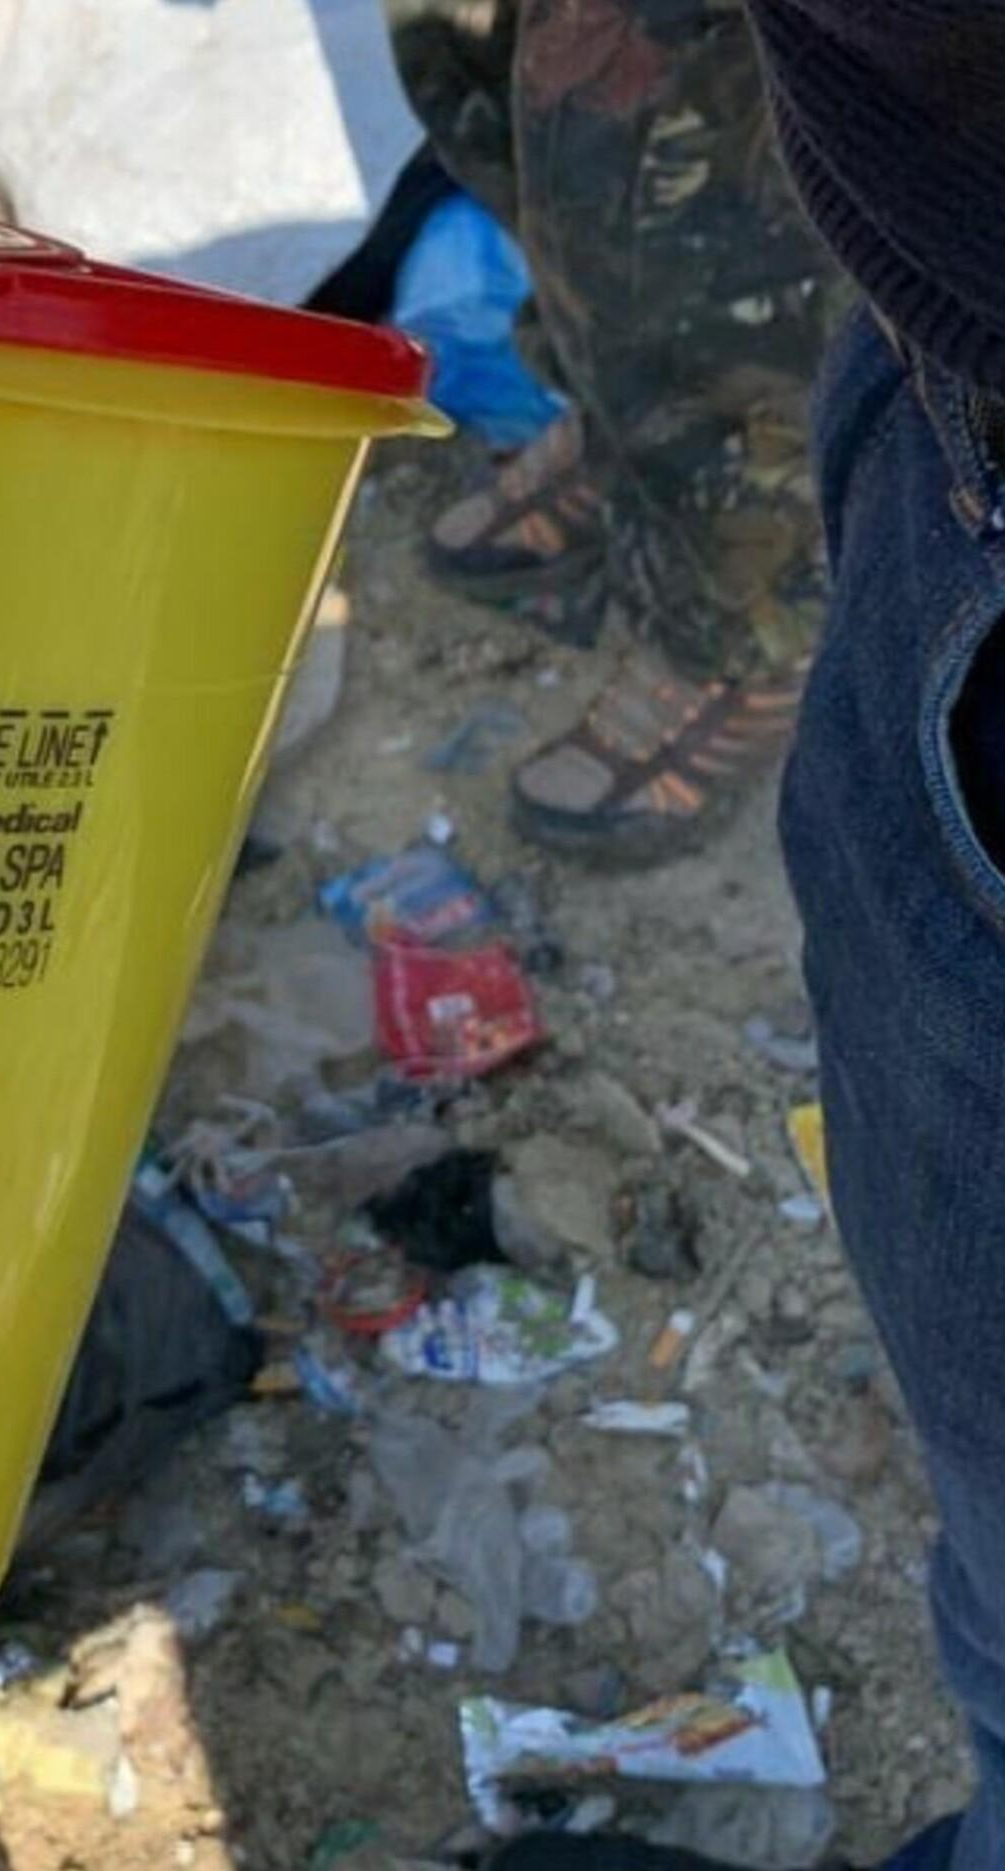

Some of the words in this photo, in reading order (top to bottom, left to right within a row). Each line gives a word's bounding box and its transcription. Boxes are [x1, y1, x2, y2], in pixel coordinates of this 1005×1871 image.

[18, 723, 90, 767] LINE
[0, 843, 66, 892] SPA
[16, 900, 33, 934] 3
[40, 898, 55, 932] L
